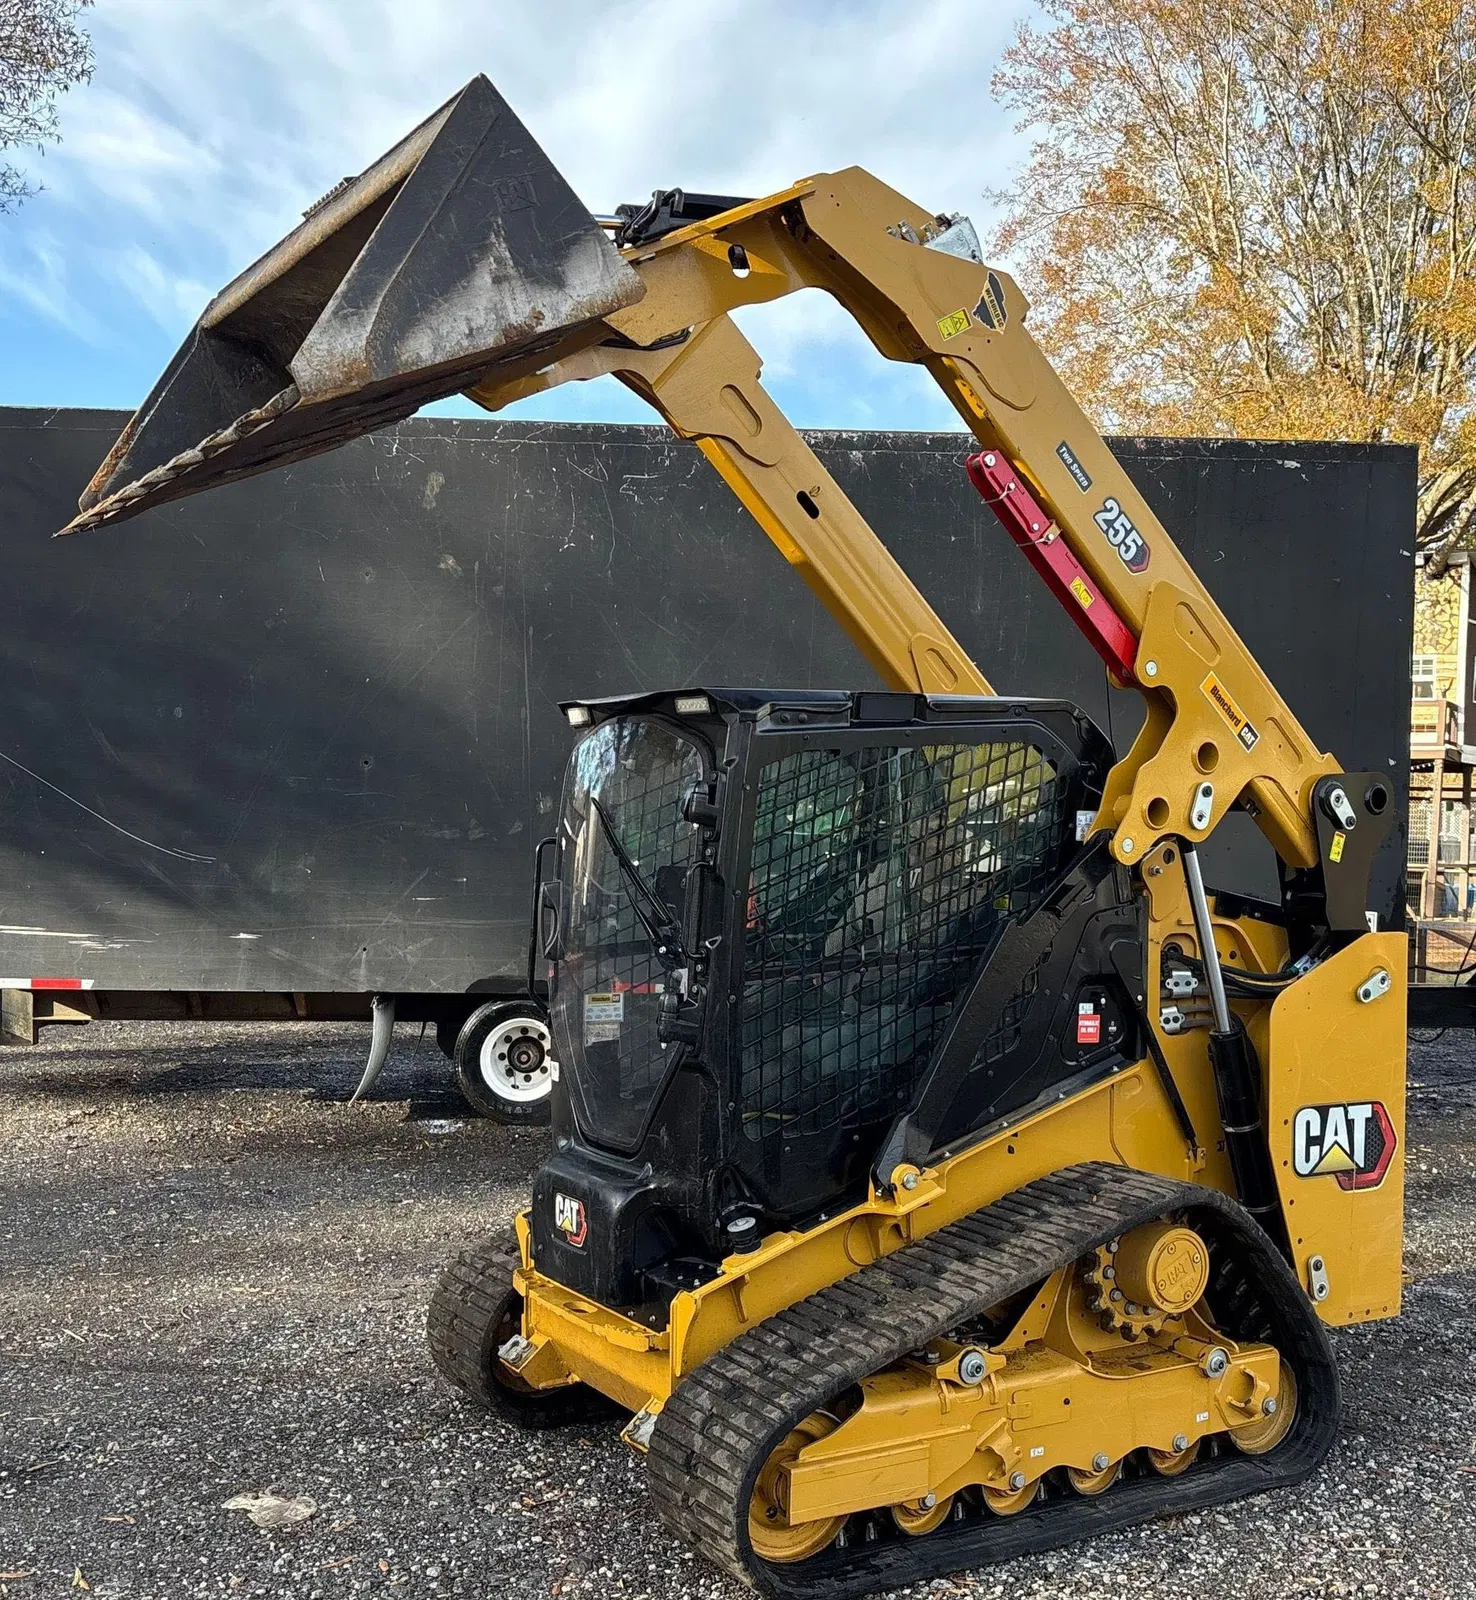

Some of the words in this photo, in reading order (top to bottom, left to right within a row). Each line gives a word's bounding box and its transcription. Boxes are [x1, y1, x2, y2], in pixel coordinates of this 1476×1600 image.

[984, 287, 993, 298] WE
[989, 299, 1001, 318] BUILD
[997, 318, 1005, 328] SC
[1058, 446, 1072, 465] TWO
[1070, 463, 1089, 487] SPEED
[1094, 499, 1144, 561] 255
[1210, 685, 1242, 727] Blanchard
[1240, 726, 1255, 745] CAT
[1295, 1104, 1372, 1174] CAT
[555, 1194, 579, 1234] CAT
